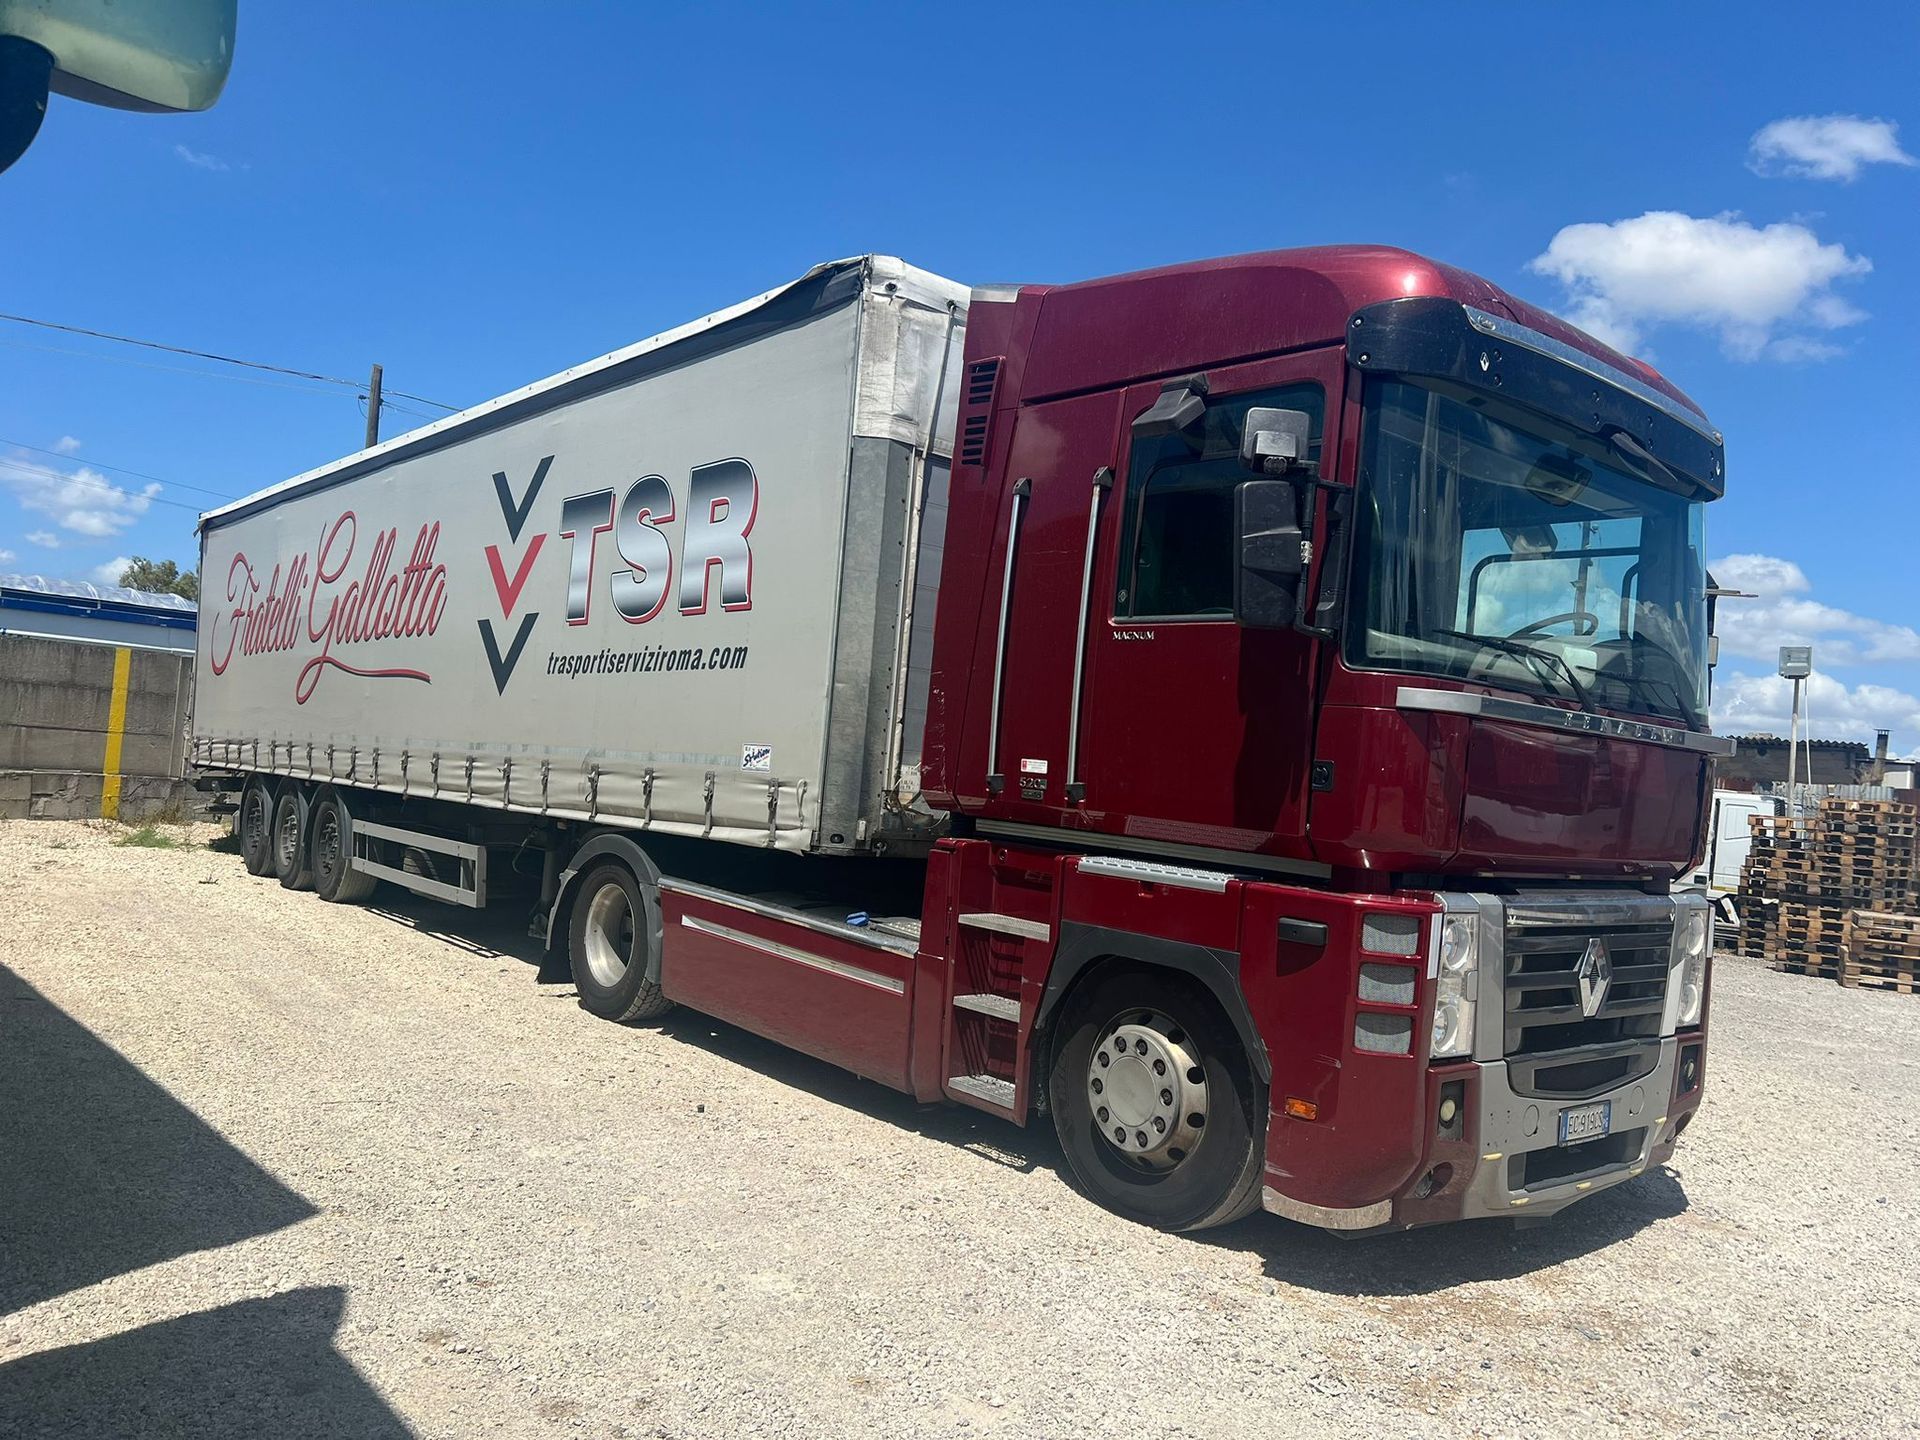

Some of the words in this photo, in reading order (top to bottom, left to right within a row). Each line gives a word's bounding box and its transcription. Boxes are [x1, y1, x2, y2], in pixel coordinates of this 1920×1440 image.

[559, 456, 759, 627] TSR
[211, 552, 309, 676] Fratelli
[296, 510, 448, 705] Gallotta
[1112, 630, 1155, 640] MAGNUM
[546, 644, 749, 680] trasportiserviziroma.com
